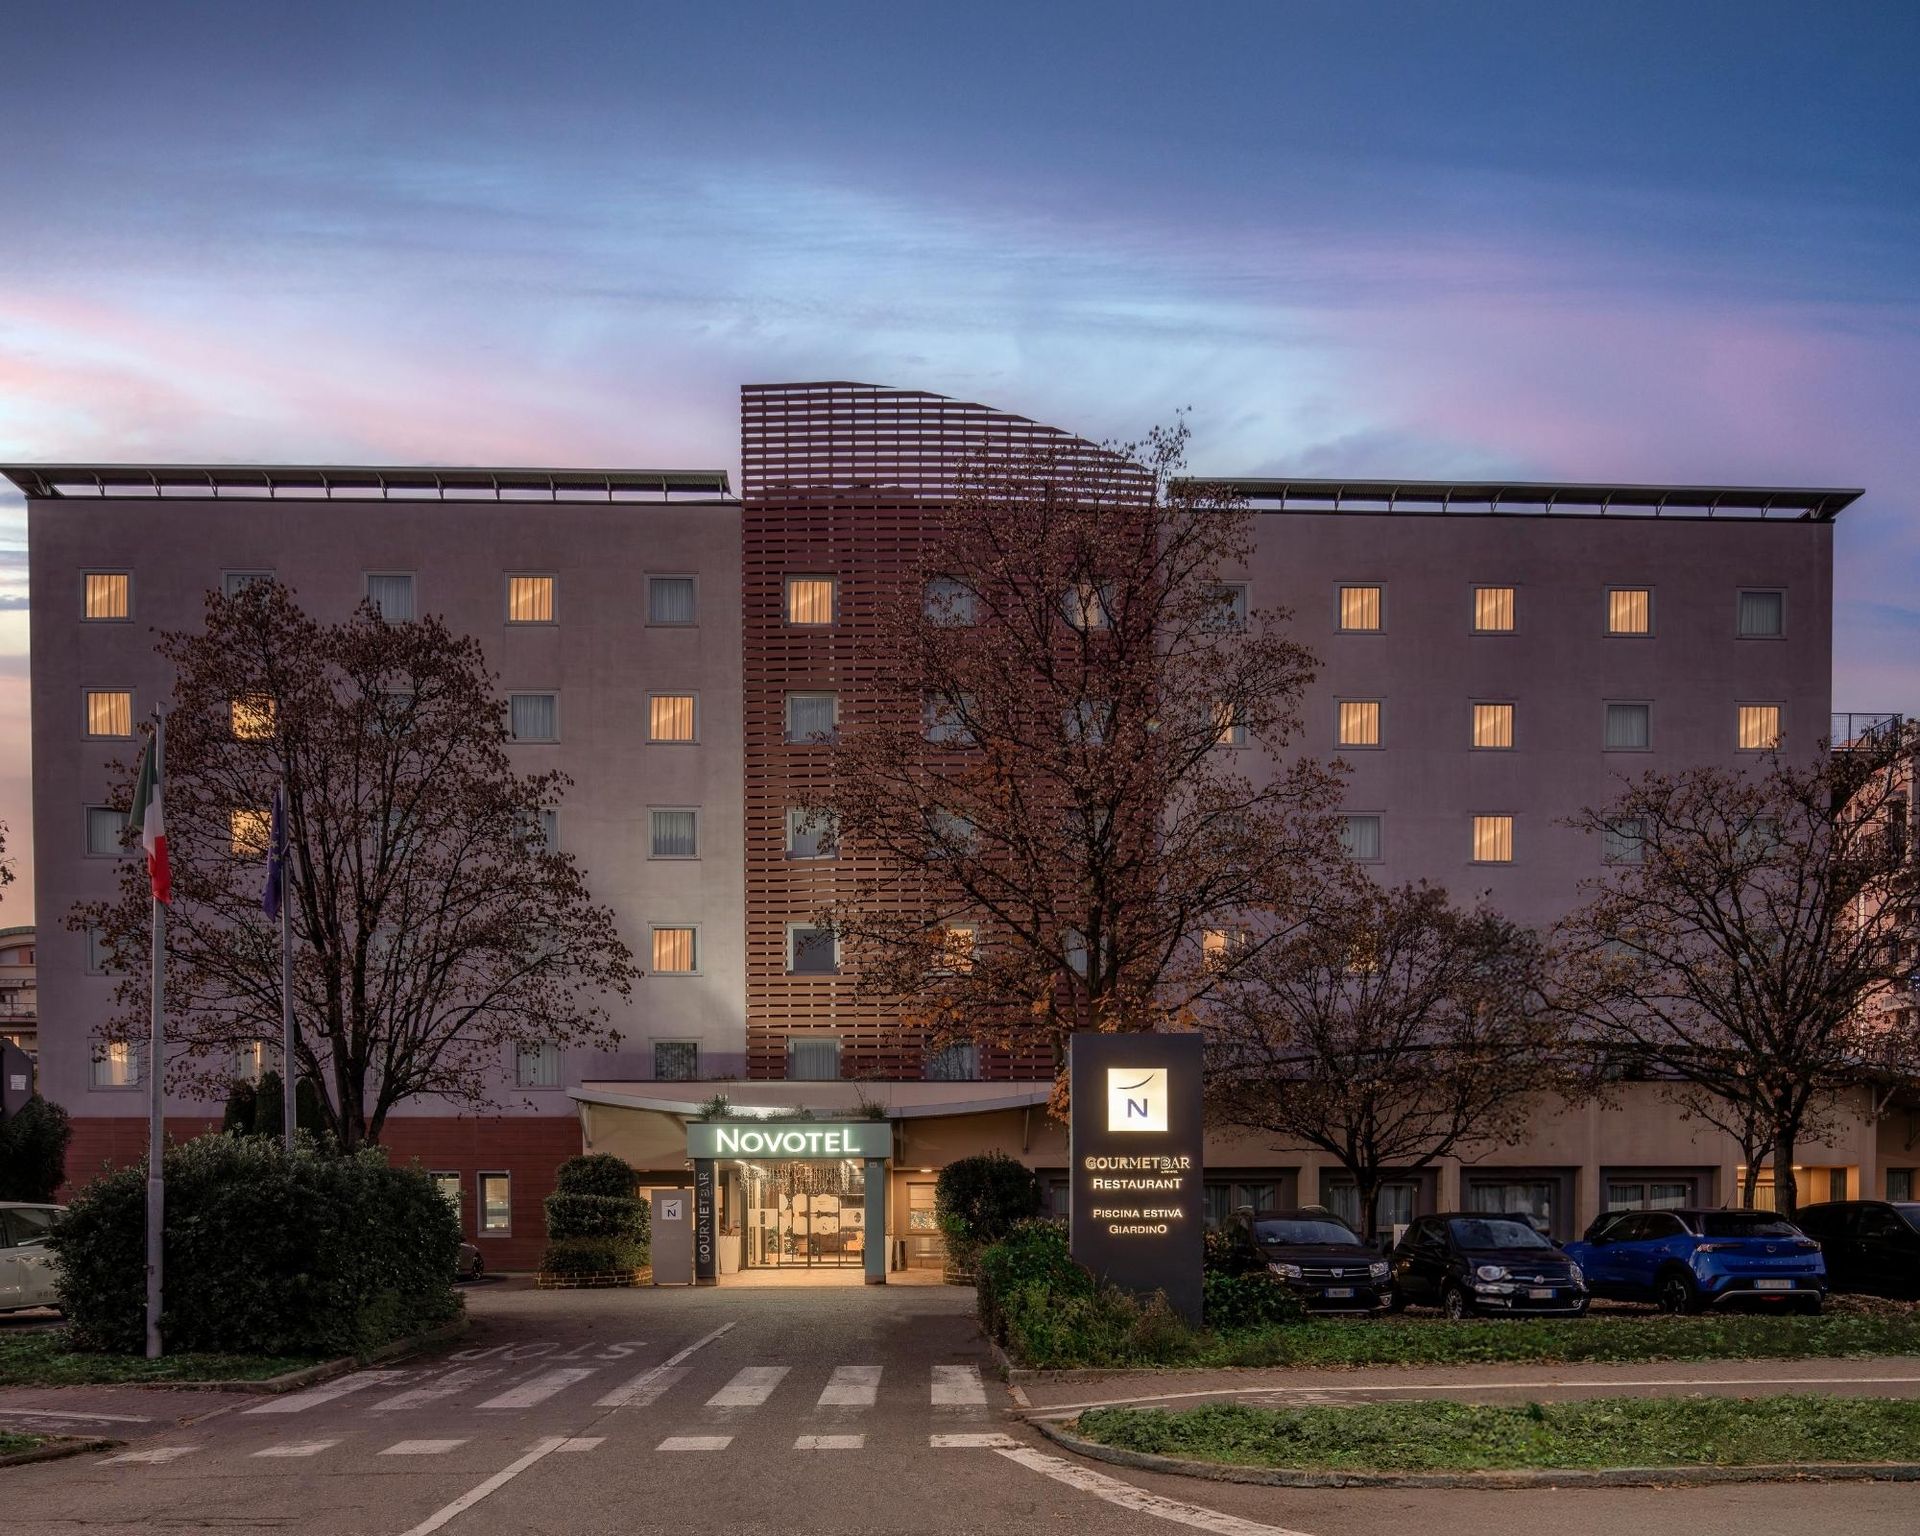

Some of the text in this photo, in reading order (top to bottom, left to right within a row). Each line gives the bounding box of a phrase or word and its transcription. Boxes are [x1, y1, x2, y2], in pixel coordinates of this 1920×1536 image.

[1127, 1098, 1148, 1118] N
[716, 1128, 861, 1153] NOVOTEL
[1093, 1178, 1183, 1190] RESTAURANT
[667, 1209, 676, 1217] N
[1093, 1208, 1183, 1219] PISCINA ESTIVA
[1109, 1224, 1168, 1235] GIARDINO
